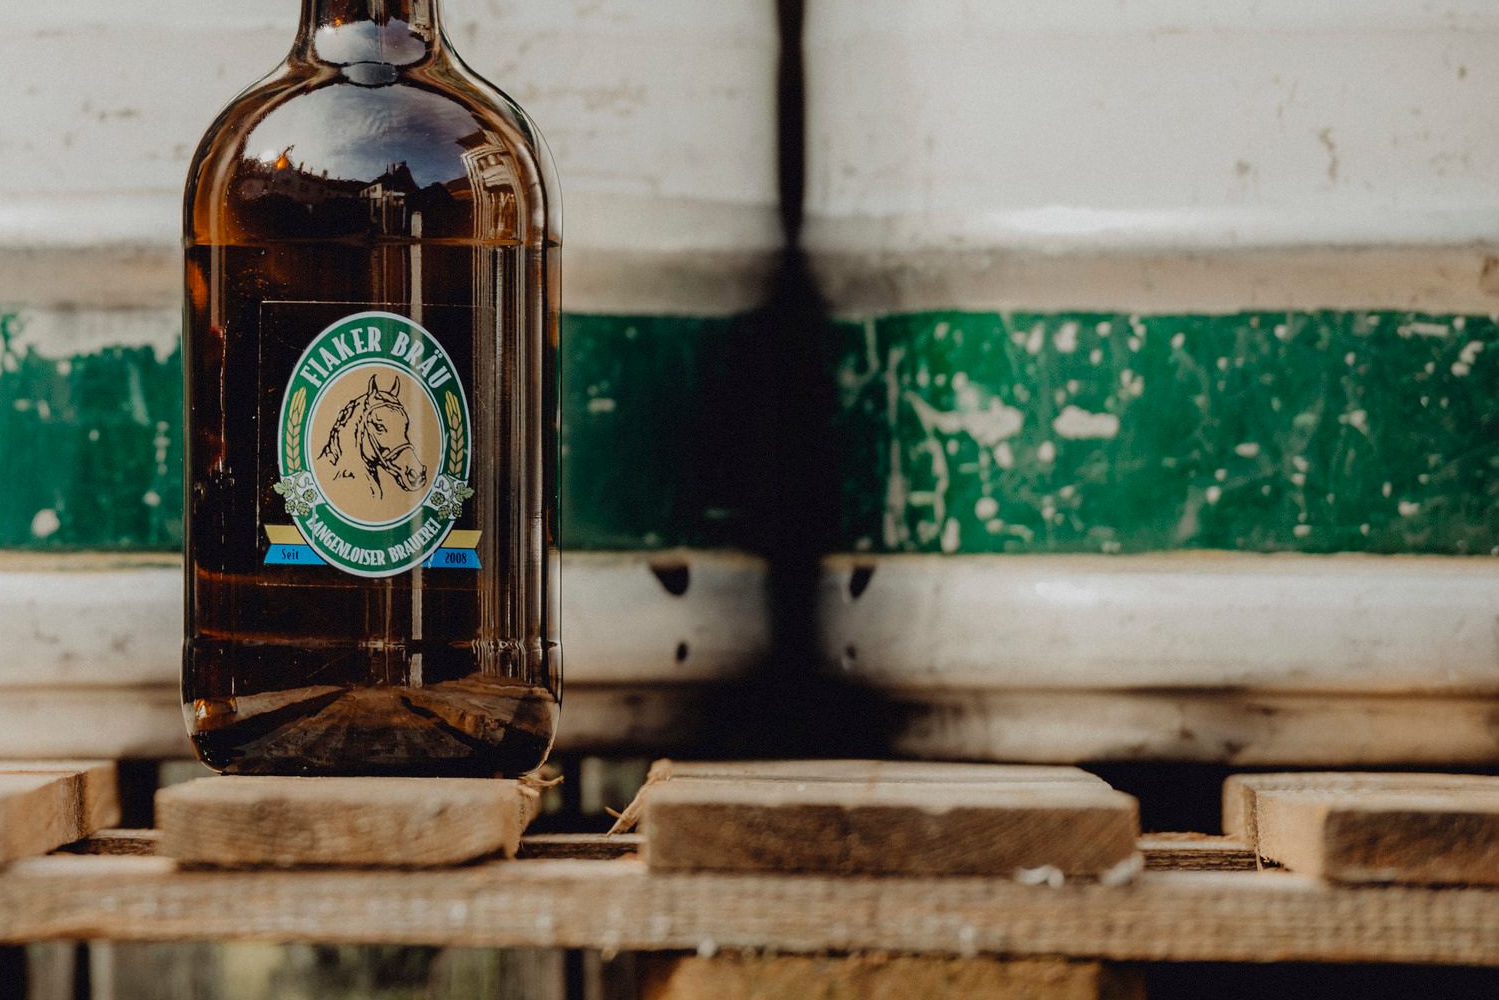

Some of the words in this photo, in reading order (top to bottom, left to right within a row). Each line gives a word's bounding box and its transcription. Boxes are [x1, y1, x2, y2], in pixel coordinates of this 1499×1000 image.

[299, 326, 382, 389] FIAKER
[390, 331, 453, 389] BRÄU
[281, 549, 299, 561] Seit
[305, 513, 387, 567] LANGENLOISER
[388, 516, 442, 565] BRAUEREI
[445, 552, 468, 565] 2008
